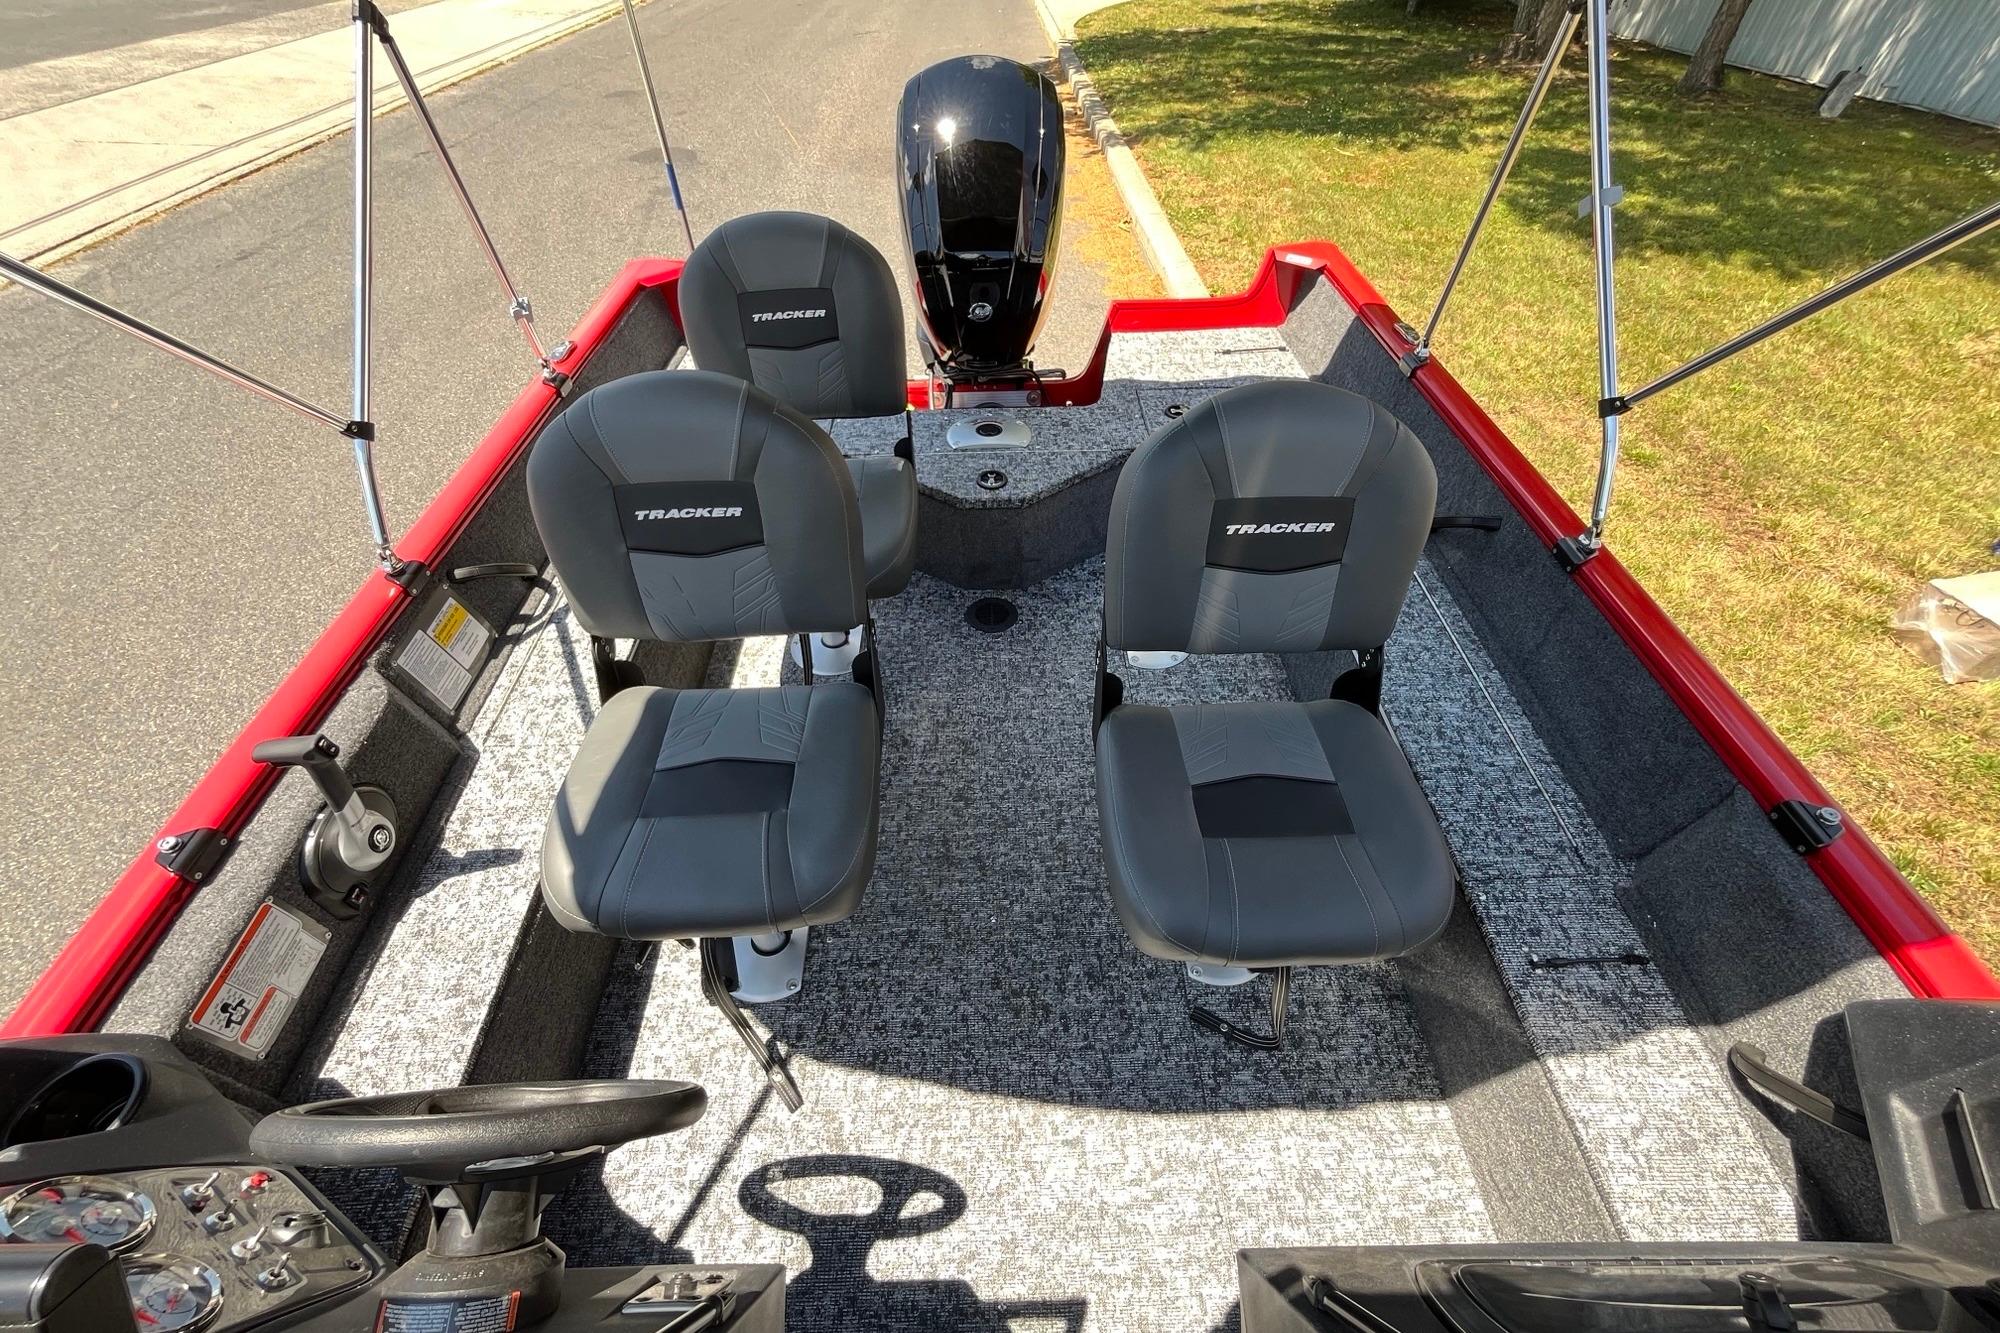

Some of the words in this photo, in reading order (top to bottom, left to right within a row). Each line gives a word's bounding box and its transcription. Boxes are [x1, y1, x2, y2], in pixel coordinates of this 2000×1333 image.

[752, 309, 826, 322] TRACKER
[634, 506, 743, 521] TRACKER
[1225, 522, 1336, 535] TRACKER
